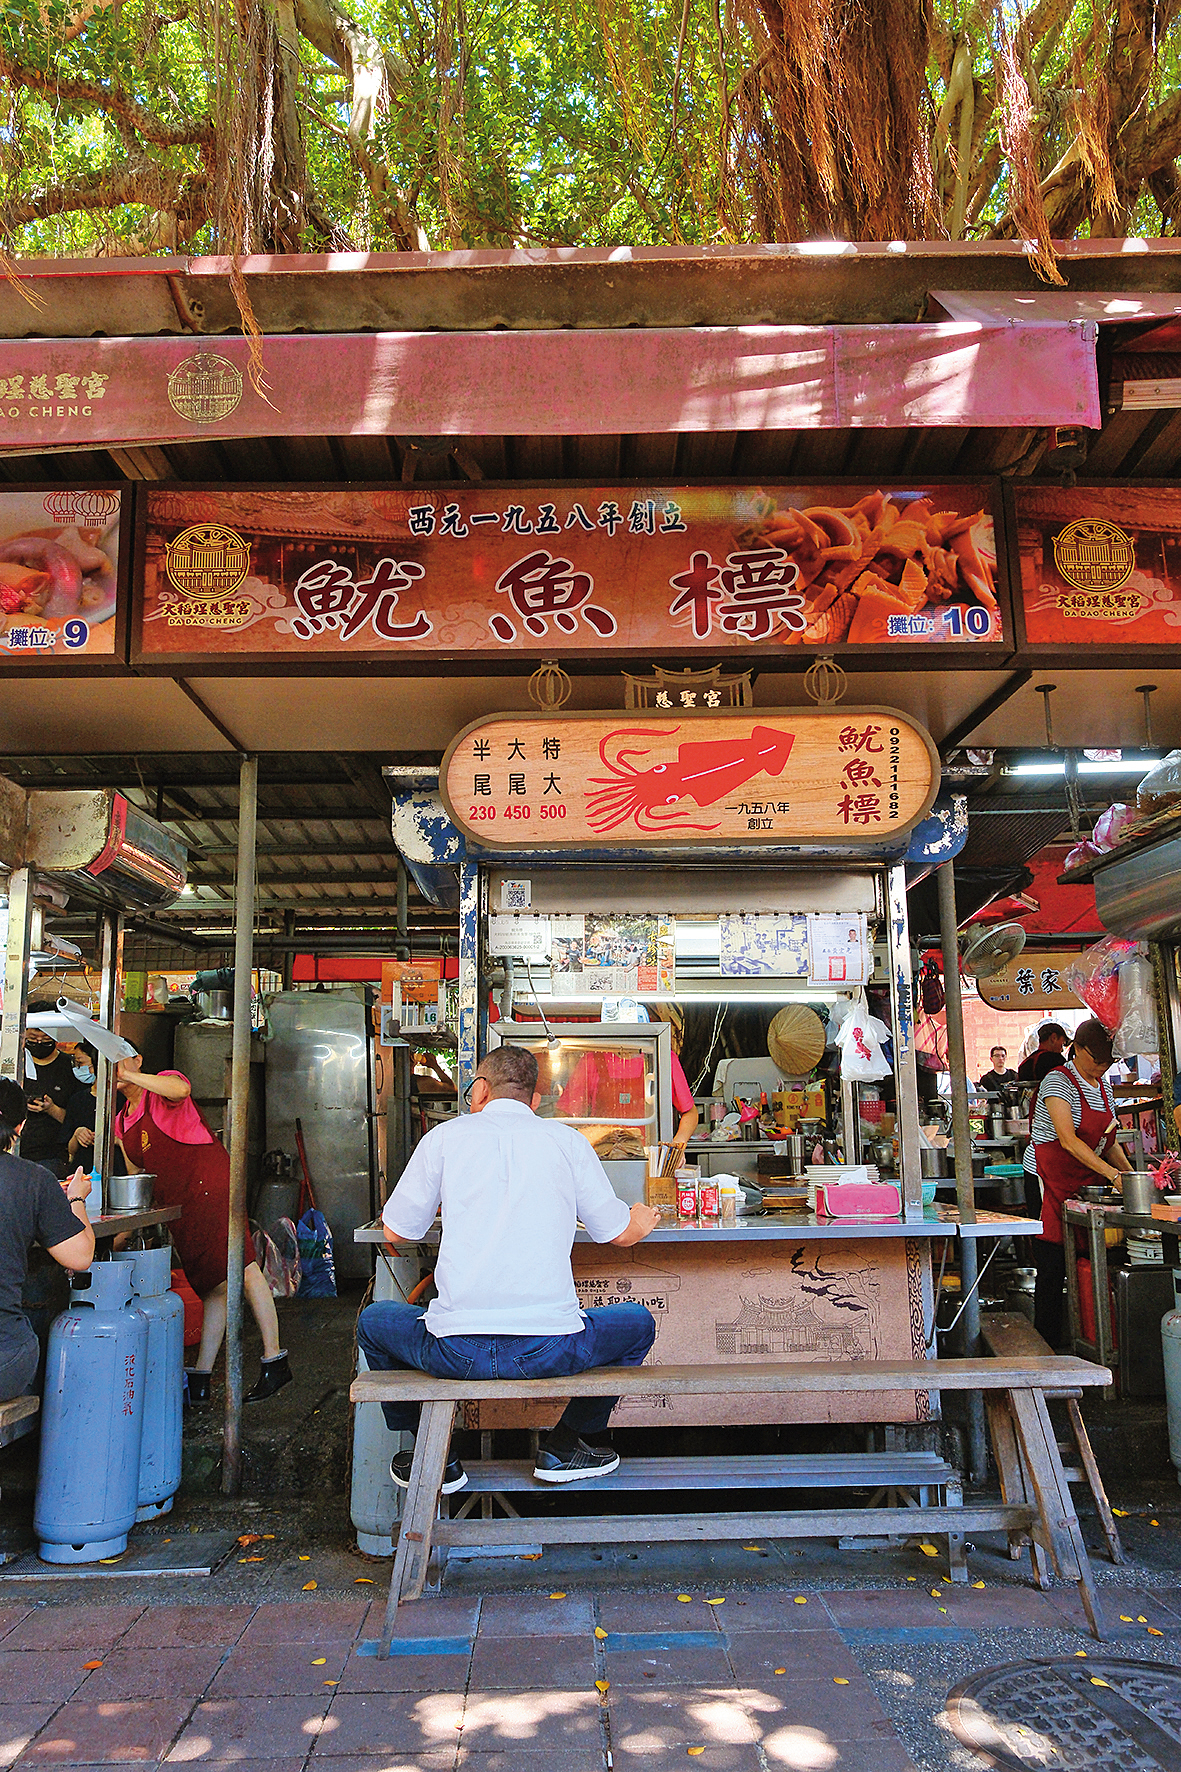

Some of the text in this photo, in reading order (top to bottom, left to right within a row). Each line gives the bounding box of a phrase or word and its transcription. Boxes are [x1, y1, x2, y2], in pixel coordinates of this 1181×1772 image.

[29, 406, 92, 417] CHENG
[408, 501, 687, 538] 西元一九五八年創立
[162, 600, 251, 616] 大稻埕慈聖宮
[292, 549, 807, 642] 魷魚標
[1056, 593, 1141, 608] 大稻埕慈聖宮
[63, 618, 90, 649] 9
[168, 618, 242, 626] DA DAO CHENG
[942, 606, 991, 636] 10
[655, 689, 722, 708] 慈聖宮
[473, 738, 491, 796] 半尾
[507, 737, 527, 796] 大尾
[542, 736, 562, 795] 特大
[836, 725, 884, 825] 魷魚標
[889, 727, 900, 819] 0922111682
[469, 804, 567, 820] 230 450 500
[725, 802, 790, 815] 一九五八年
[747, 818, 774, 830] 創立
[1015, 967, 1073, 995] 葉家
